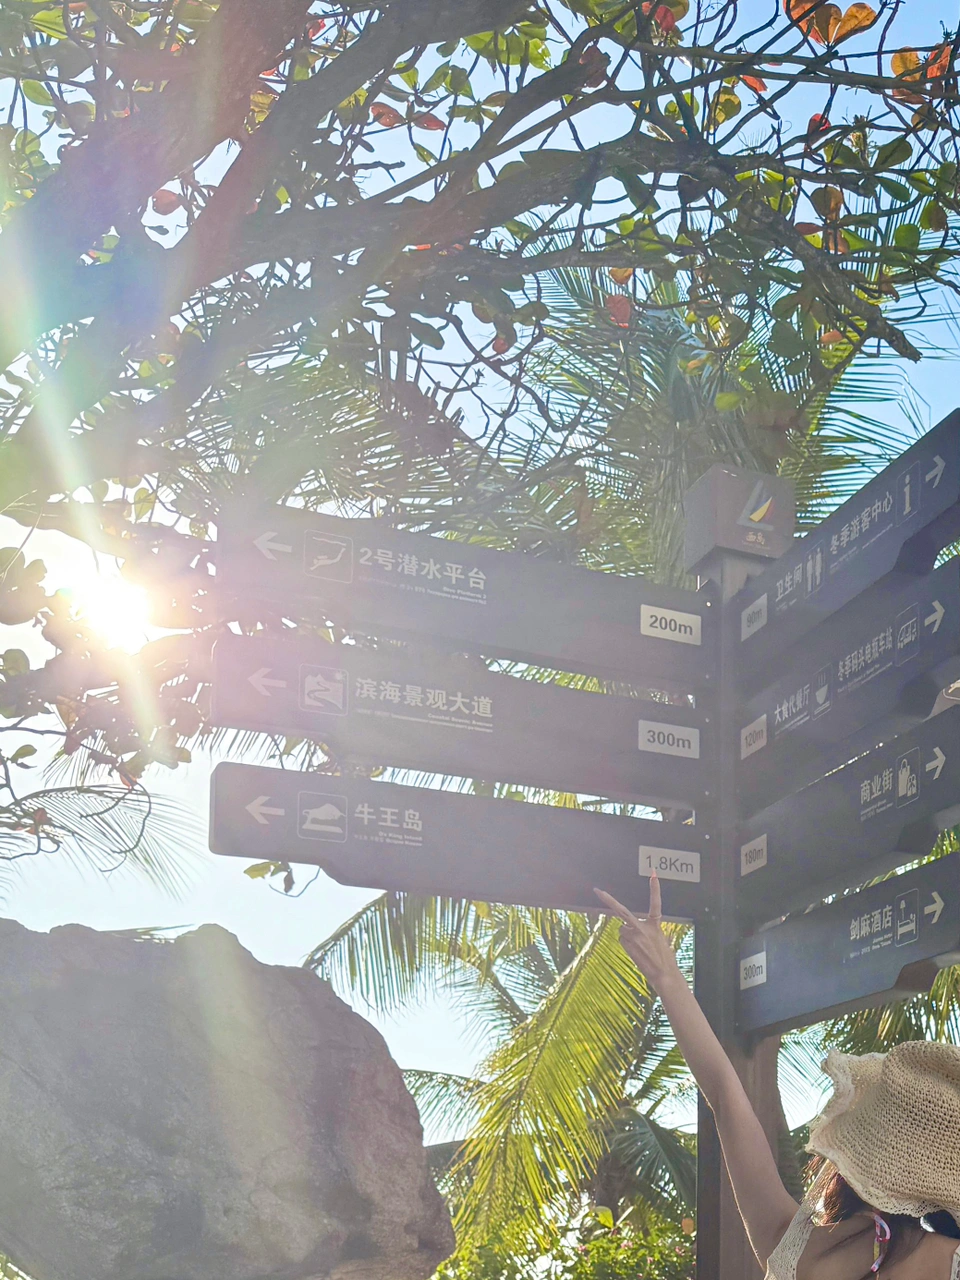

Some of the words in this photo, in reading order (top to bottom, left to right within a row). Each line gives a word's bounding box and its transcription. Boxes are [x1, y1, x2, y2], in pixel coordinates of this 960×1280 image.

[830, 491, 893, 555] 冬季游客中心
[359, 547, 487, 590] 2号潜水平台
[775, 563, 803, 602] 卫生间
[649, 614, 694, 636] 200m
[355, 677, 493, 718] 滨海景观大道
[774, 683, 810, 726] 大食代餐厅
[647, 729, 692, 750] 300m
[744, 726, 764, 749] 120m
[860, 767, 893, 805] 商业街
[354, 802, 423, 832] 牛王岛
[646, 854, 694, 874] 1.8Km
[744, 846, 764, 866] 180m
[849, 904, 893, 941] 剑麻酒店
[743, 960, 764, 982] 300m
